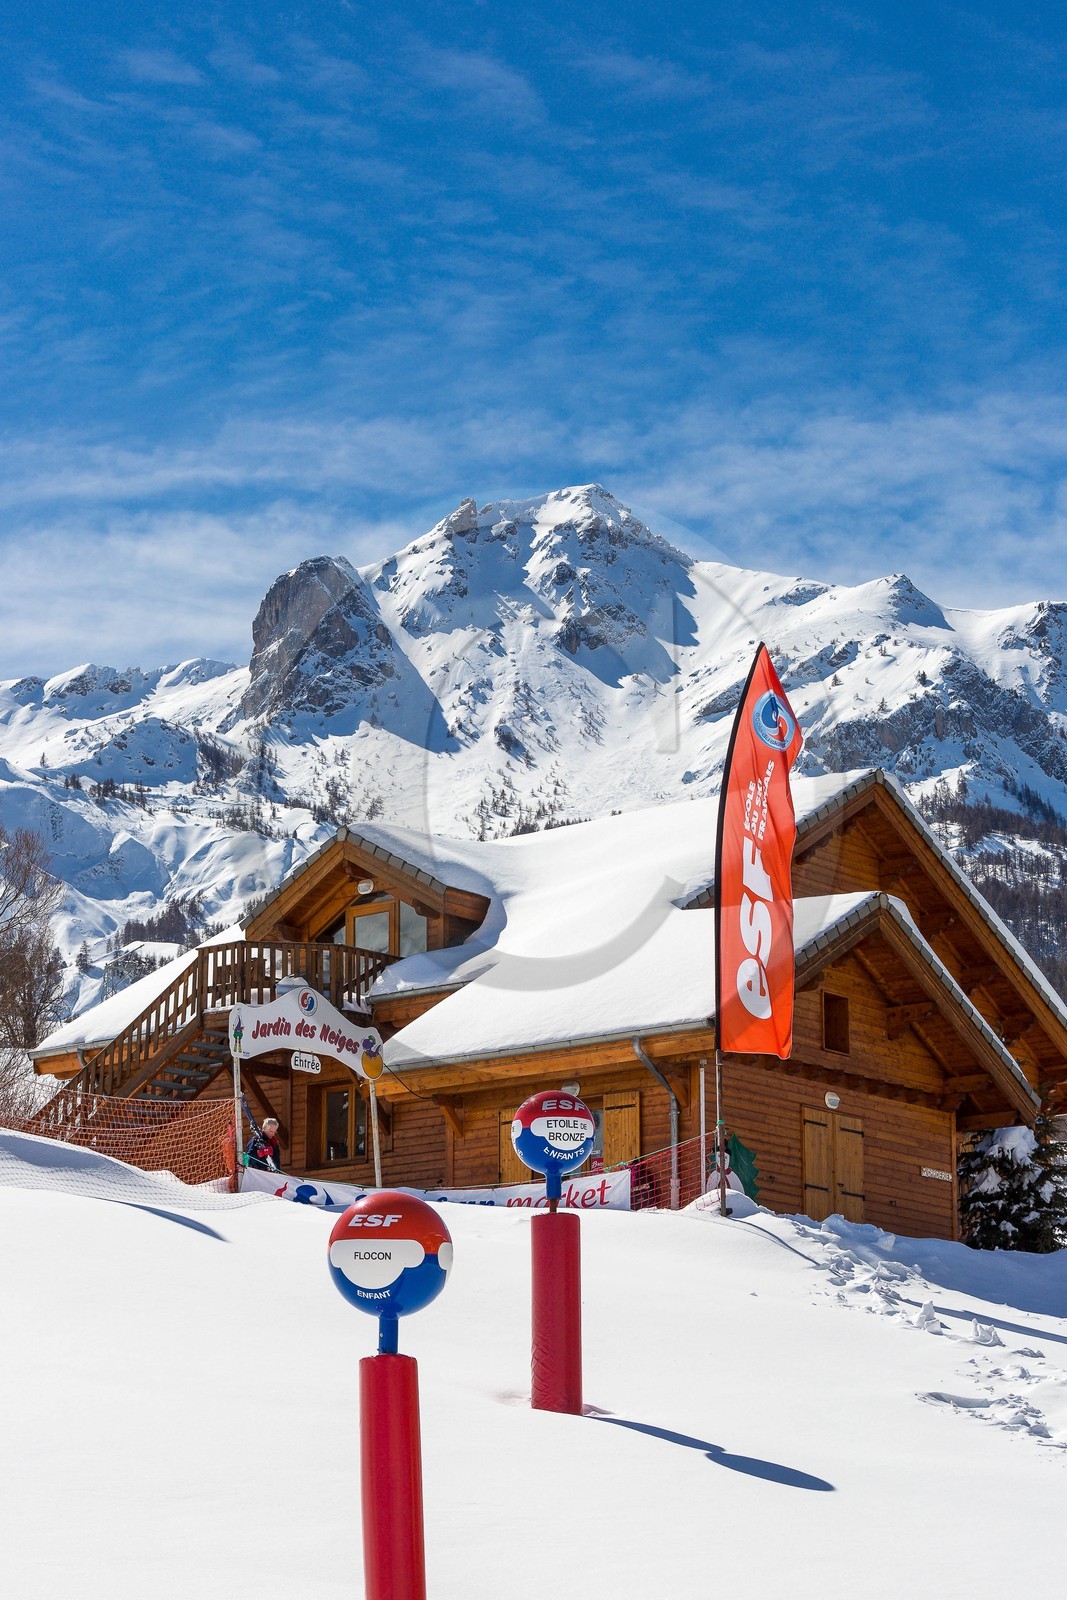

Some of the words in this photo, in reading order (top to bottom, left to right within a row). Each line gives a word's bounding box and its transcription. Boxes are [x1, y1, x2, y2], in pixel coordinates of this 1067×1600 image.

[751, 809, 759, 835] DU
[252, 1016, 291, 1040] Jardin
[295, 1018, 317, 1039] des
[319, 1023, 360, 1055] Neiges
[294, 1055, 320, 1071] Entrée
[541, 1099, 586, 1112] ESF
[546, 1119, 579, 1129] ETOILE
[580, 1122, 588, 1131] DE
[548, 1131, 585, 1142] BRONZE
[543, 1146, 585, 1160] ENFANTS
[348, 1214, 403, 1228] ESF
[353, 1251, 392, 1261] FLOCON
[356, 1289, 391, 1300] ENFANT
